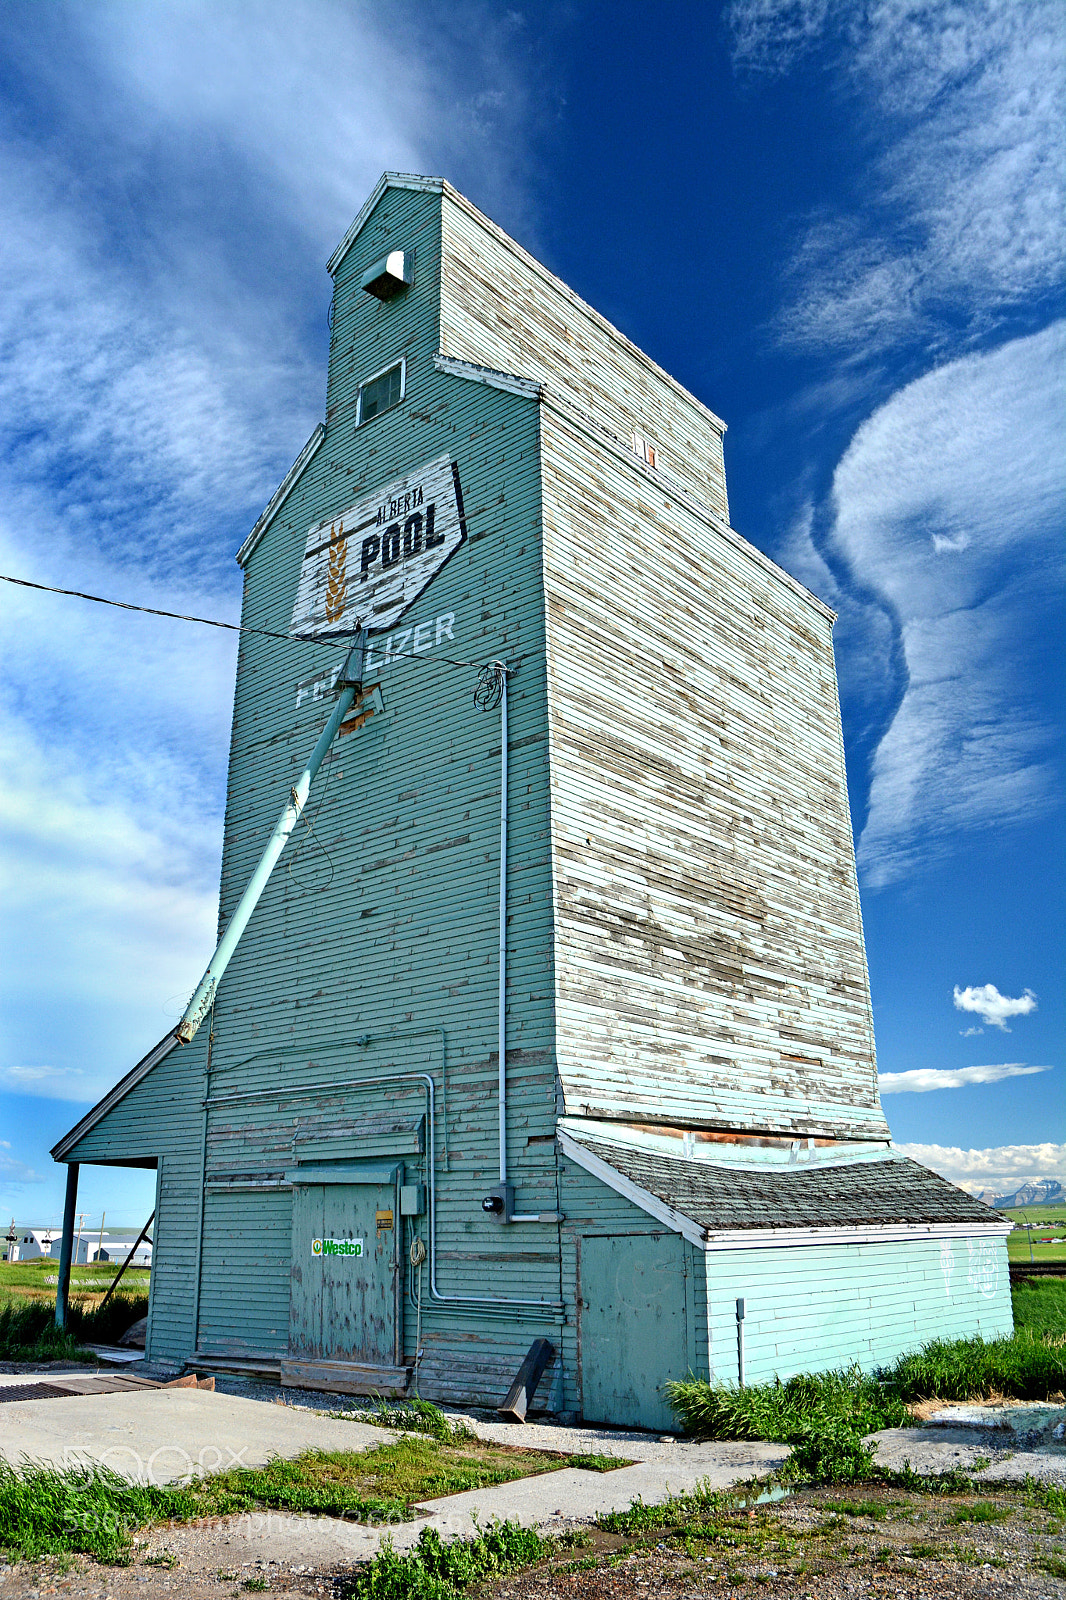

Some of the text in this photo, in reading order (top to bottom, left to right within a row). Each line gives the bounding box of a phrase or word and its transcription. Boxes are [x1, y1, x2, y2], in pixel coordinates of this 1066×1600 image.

[376, 486, 424, 527] ALBERTA
[360, 503, 446, 583] POOL
[323, 1240, 361, 1255] Westco
